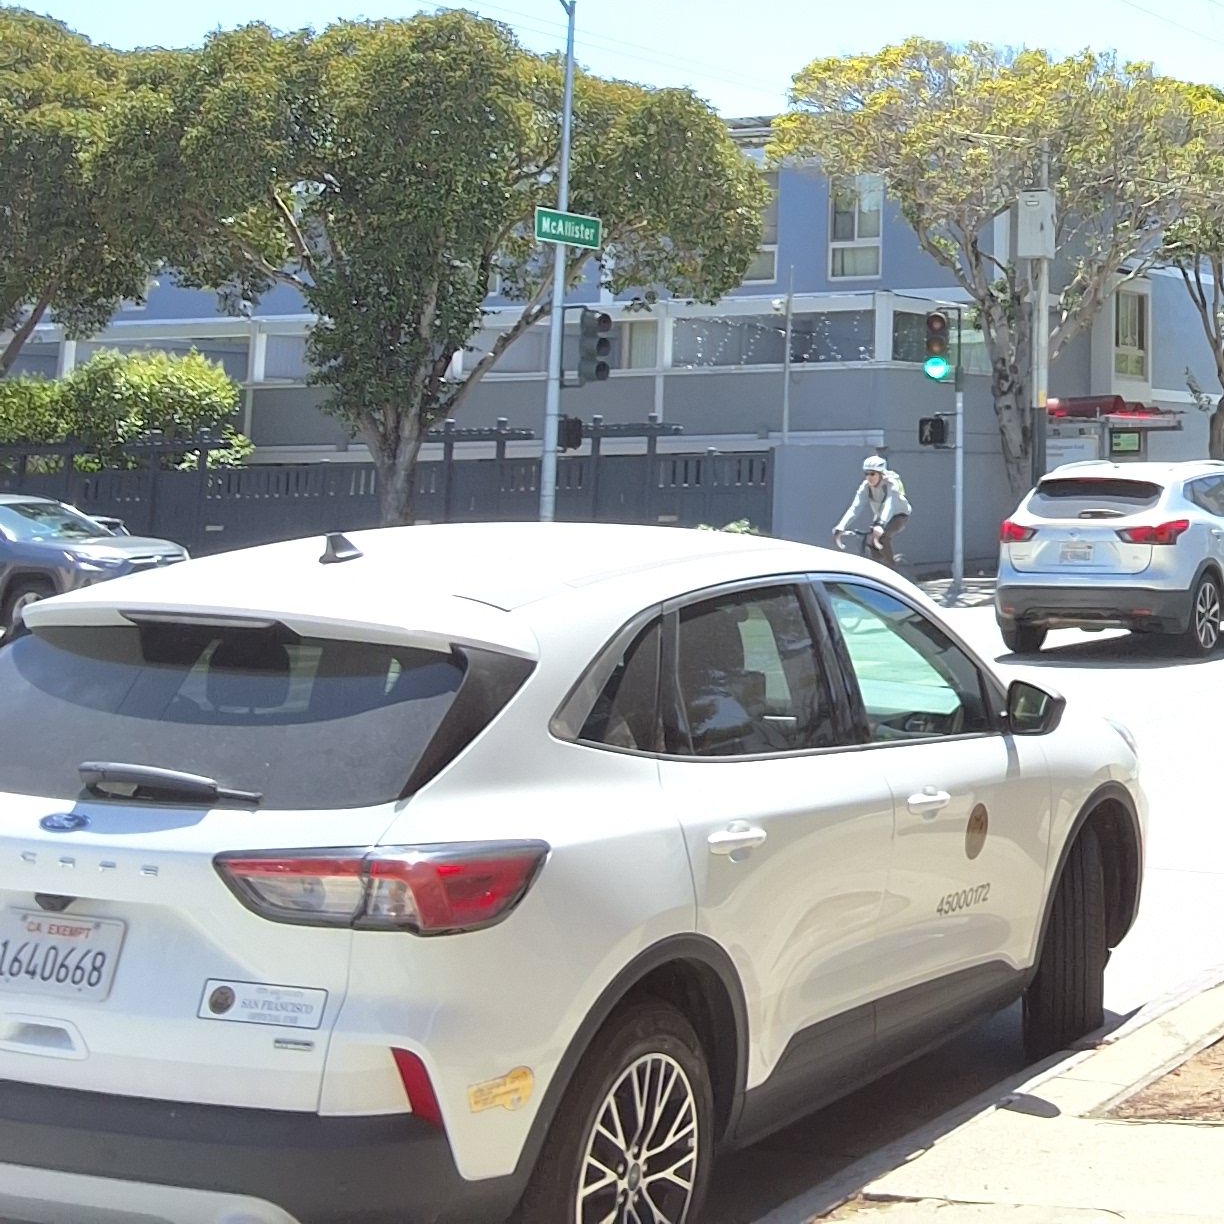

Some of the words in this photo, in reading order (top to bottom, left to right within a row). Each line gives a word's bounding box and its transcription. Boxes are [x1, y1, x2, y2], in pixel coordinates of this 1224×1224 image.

[541, 217, 595, 241] McAllister
[936, 882, 991, 916] 45000172
[48, 924, 92, 938] EXEMPT
[241, 999, 259, 1009] SAN
[261, 1000, 314, 1014] FRANCISCO
